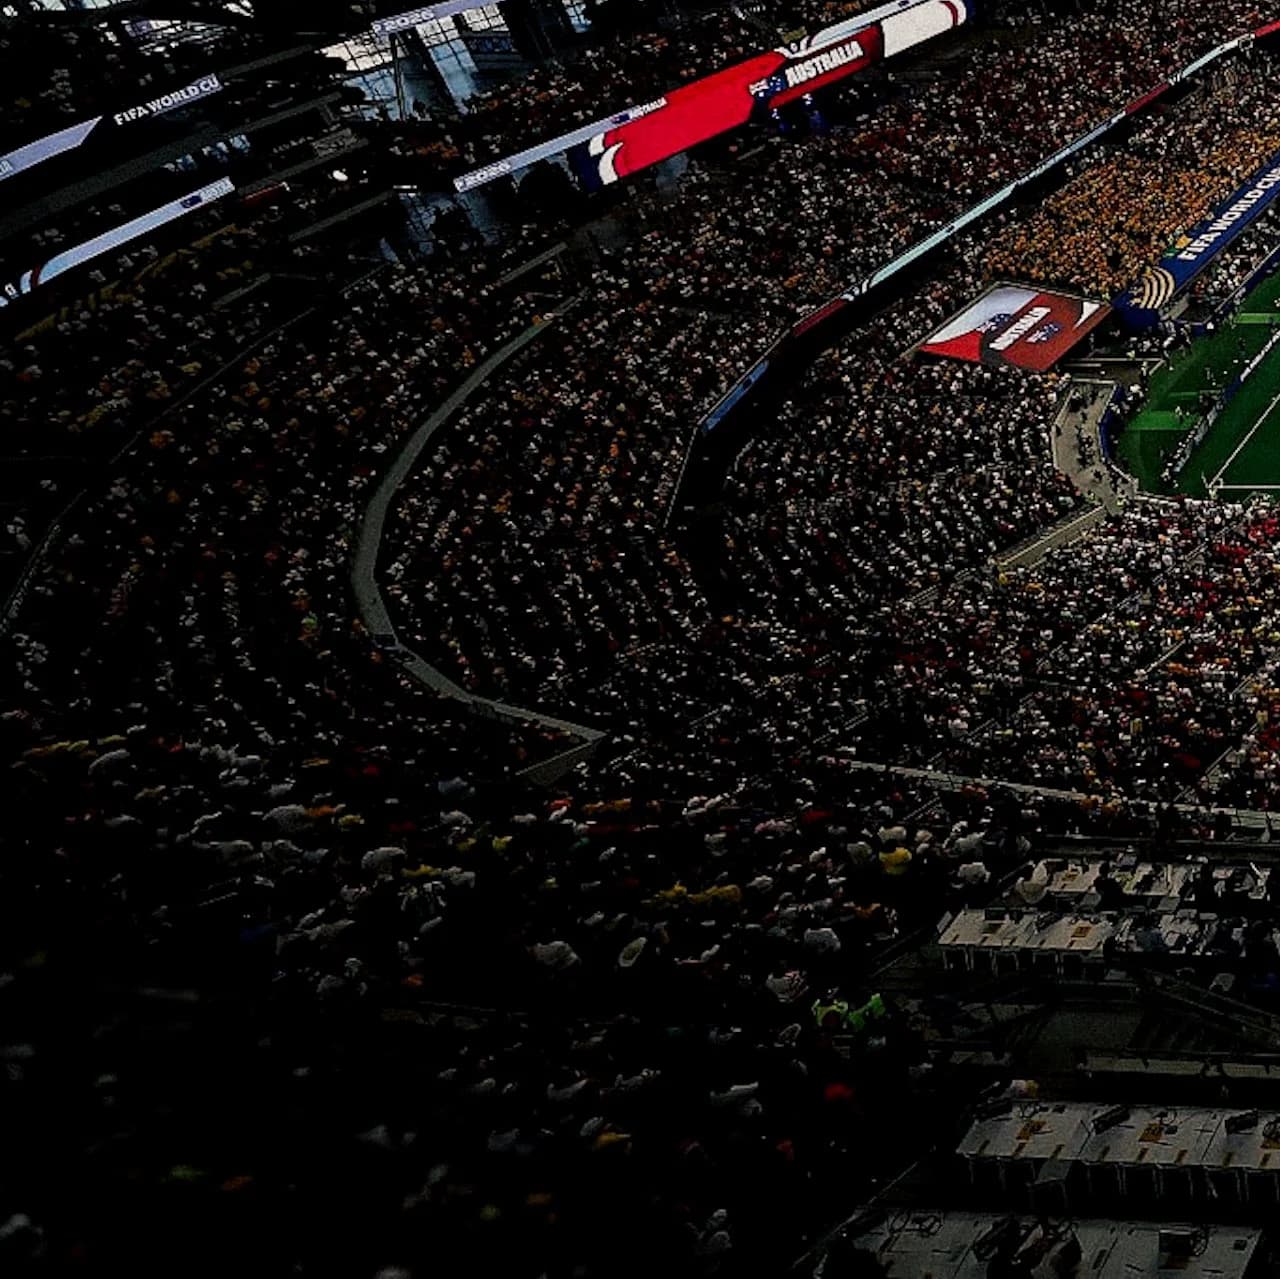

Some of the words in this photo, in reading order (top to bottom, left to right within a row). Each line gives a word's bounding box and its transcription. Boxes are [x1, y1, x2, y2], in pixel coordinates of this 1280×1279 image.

[784, 39, 864, 88] AUSTRALIA
[112, 105, 150, 126] FIFA
[147, 84, 202, 113] WORLD
[1177, 231, 1222, 261] FIFA
[1208, 188, 1265, 231] WORLD
